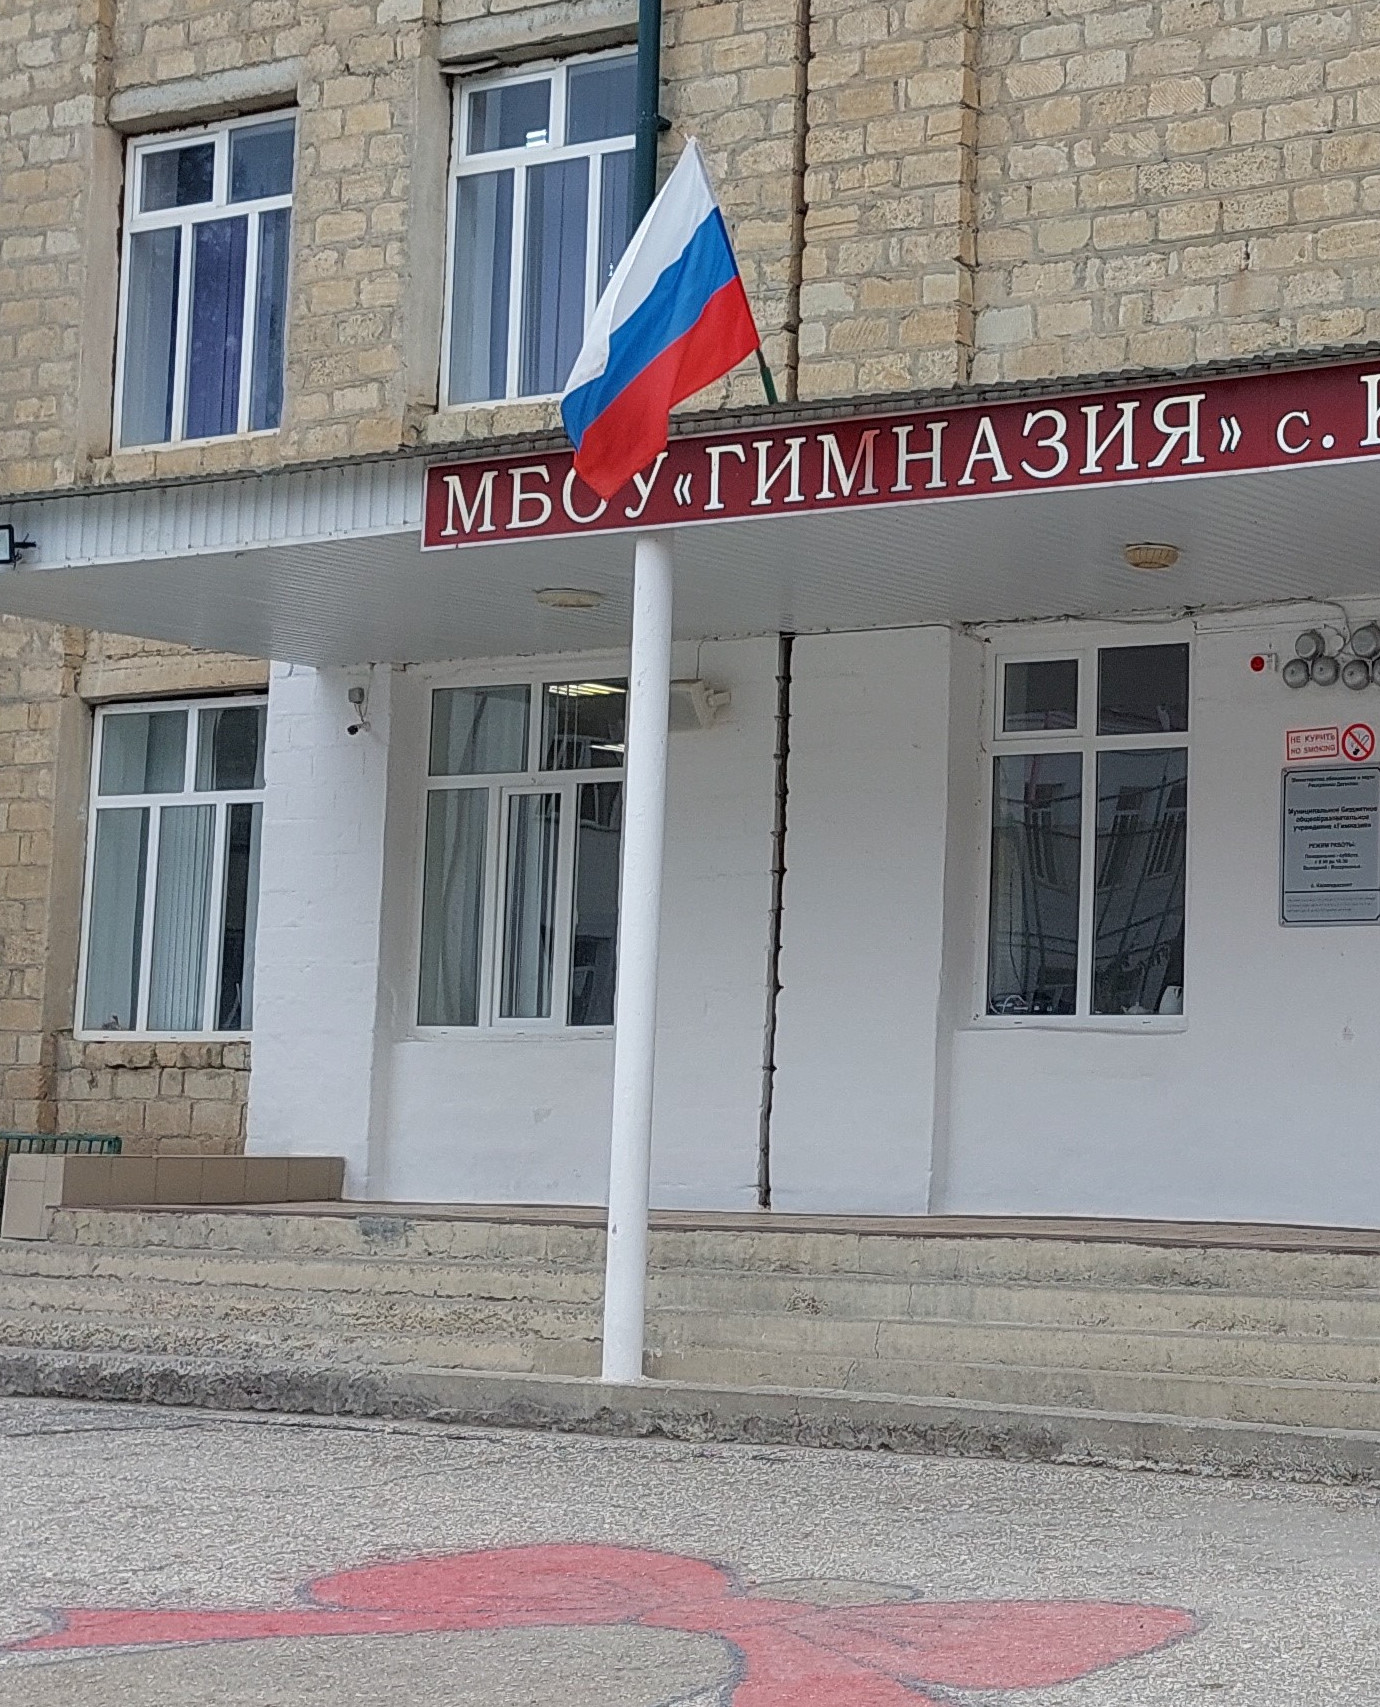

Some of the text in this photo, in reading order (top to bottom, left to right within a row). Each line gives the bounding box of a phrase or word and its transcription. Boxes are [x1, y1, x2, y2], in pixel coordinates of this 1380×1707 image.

[672, 393, 1242, 510] «ГИМНАЗИЯ»
[1275, 411, 1335, 455] с.
[1290, 732, 1336, 744] НЕ КУРИТЬ
[1290, 747, 1301, 755] NO
